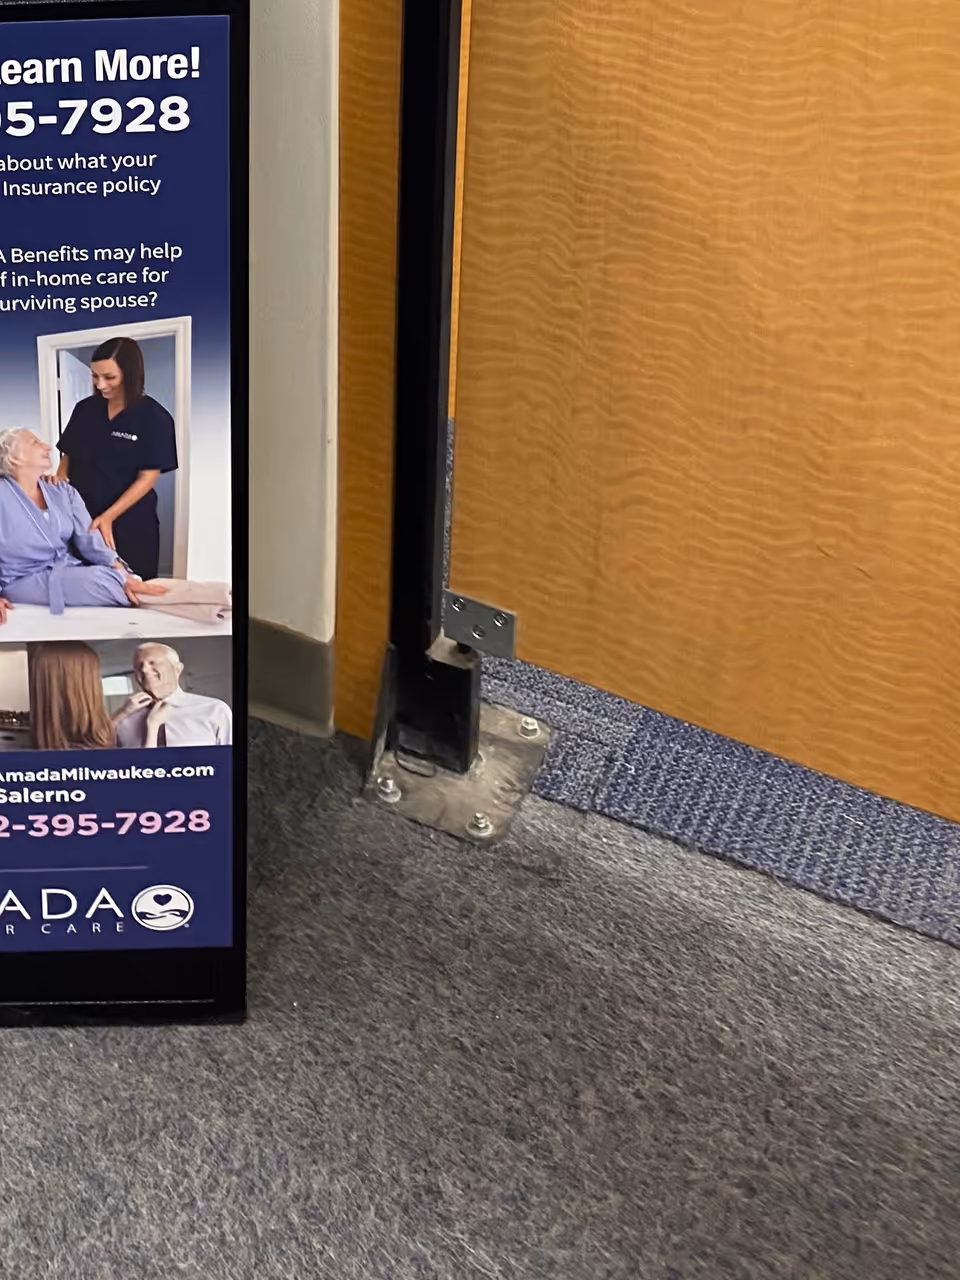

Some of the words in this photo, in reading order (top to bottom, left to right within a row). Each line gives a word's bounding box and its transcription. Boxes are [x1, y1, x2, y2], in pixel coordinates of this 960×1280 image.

[95, 46, 200, 82] More!
[3, 180, 98, 197] Insurance
[102, 175, 162, 198] policy
[11, 245, 89, 263] Benefits
[94, 247, 136, 264] may
[140, 242, 183, 263] help
[41, 921, 125, 935] CARE
